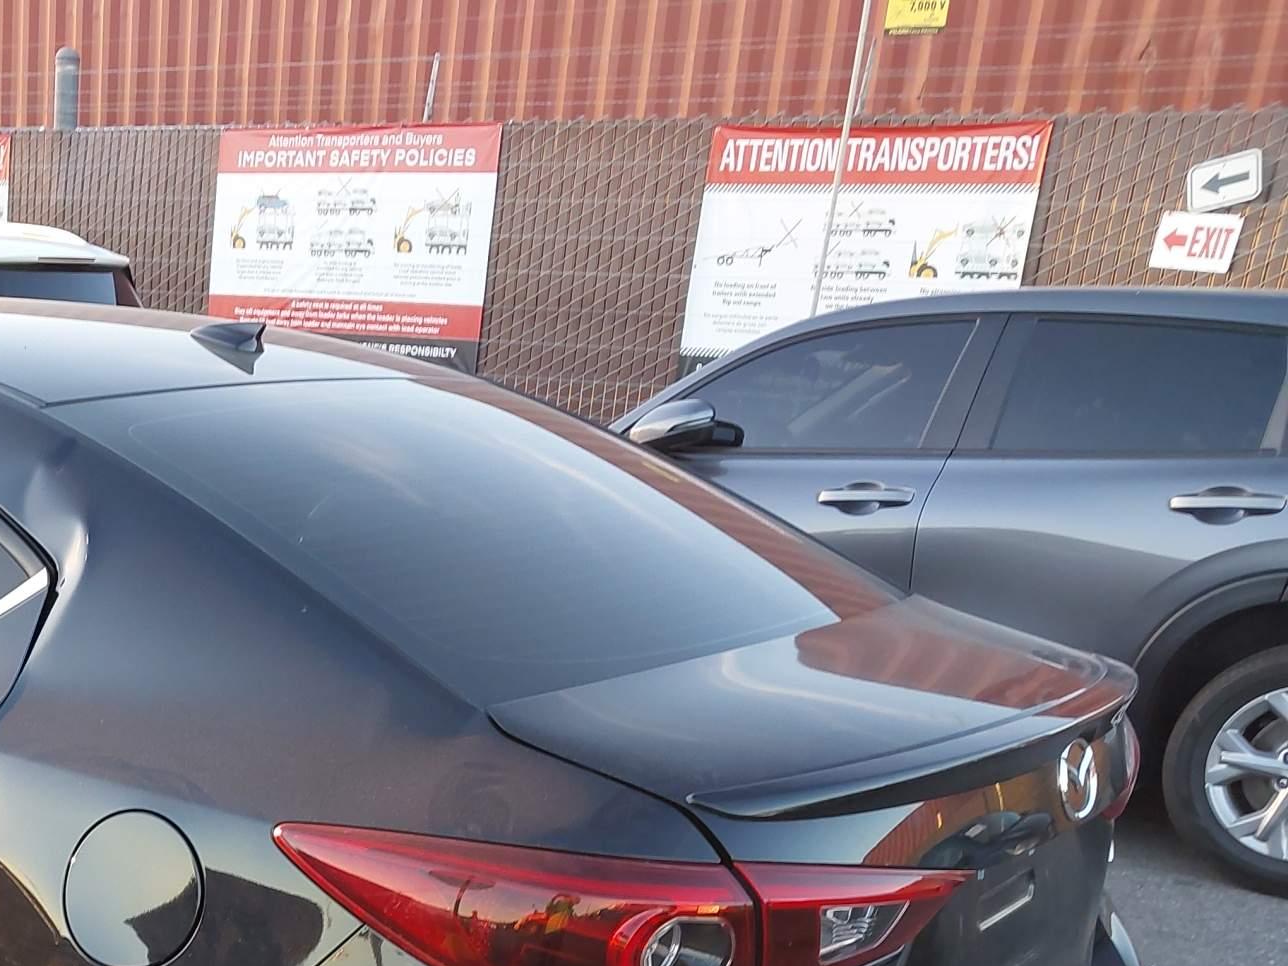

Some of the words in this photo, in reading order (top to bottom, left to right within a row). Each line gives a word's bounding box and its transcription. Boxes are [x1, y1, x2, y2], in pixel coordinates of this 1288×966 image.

[268, 134, 313, 148] Attention
[315, 133, 380, 148] Transporters
[381, 133, 404, 146] and
[404, 132, 444, 148] Buyers
[719, 138, 842, 172] ATTENTION
[845, 134, 1041, 172] TRANSPORTERS!
[237, 149, 325, 168] IMPORTANT
[328, 149, 392, 168] SAFETY
[393, 147, 477, 167] POLICIES
[1186, 225, 1236, 260] EXIT
